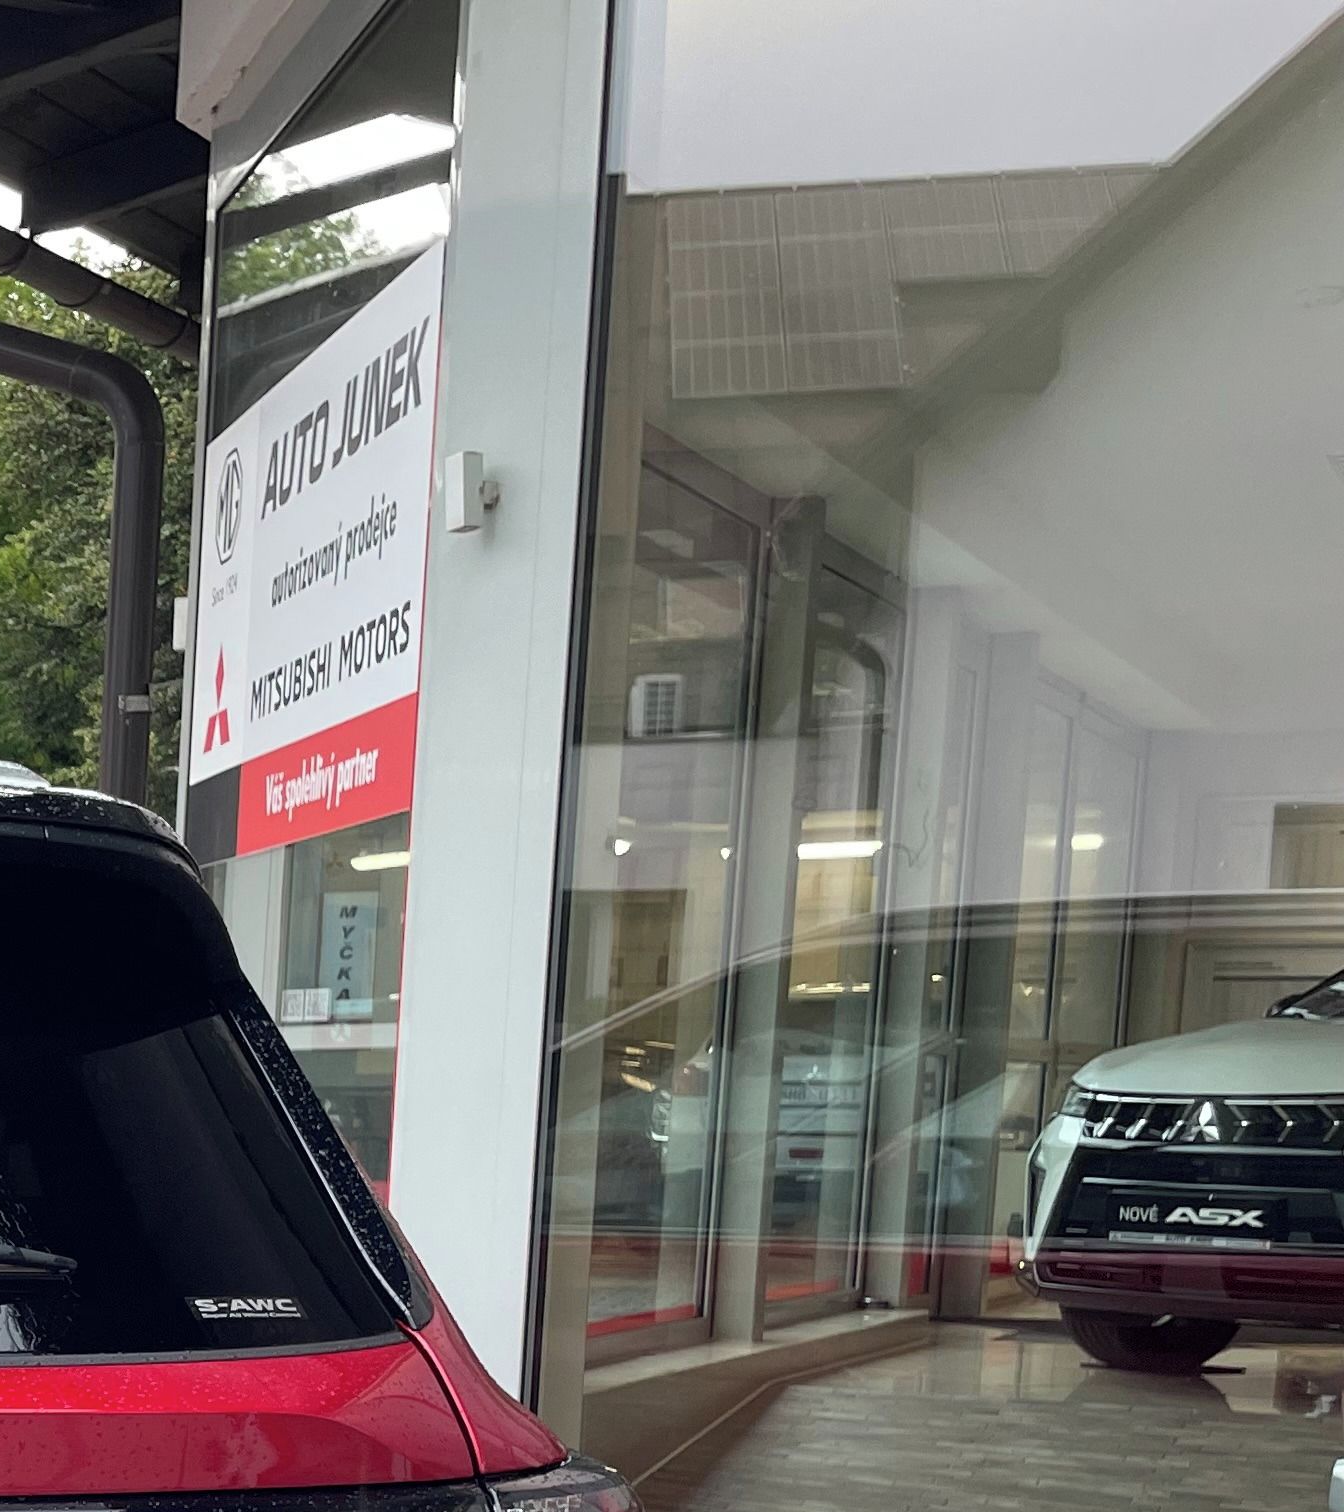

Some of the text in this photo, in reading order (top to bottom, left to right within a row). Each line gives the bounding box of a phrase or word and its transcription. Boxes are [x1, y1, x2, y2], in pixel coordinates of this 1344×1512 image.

[261, 315, 430, 520] AUTO JUNEK
[216, 453, 242, 559] MG
[271, 492, 398, 608] autorizovaný prodejce
[250, 599, 412, 723] MITSUBISHI MOTORS
[265, 747, 379, 823] Váš spolehlivý partner
[335, 905, 358, 1000] MYČKA
[1118, 1203, 1265, 1229] NOVÉ ASX
[194, 1298, 298, 1312] S-AWC
